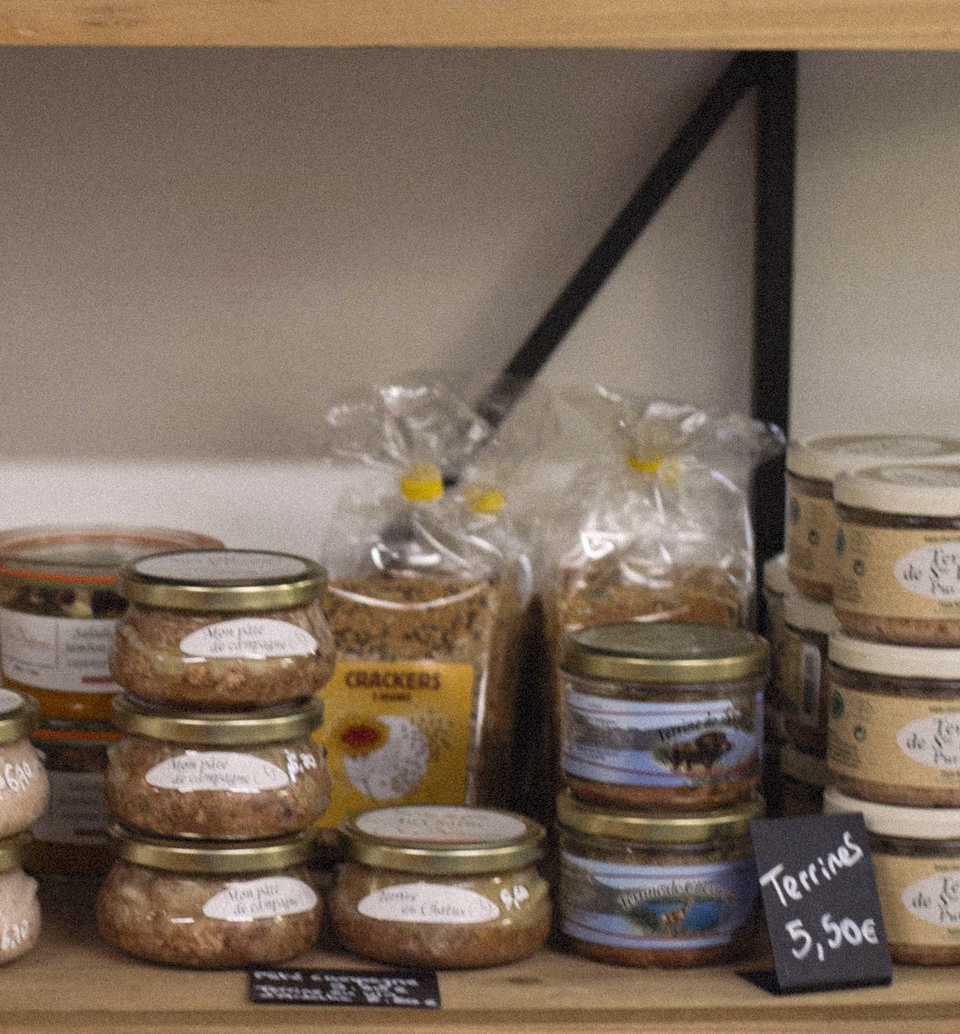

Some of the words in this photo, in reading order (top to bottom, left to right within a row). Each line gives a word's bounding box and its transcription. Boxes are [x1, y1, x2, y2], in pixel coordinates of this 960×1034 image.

[344, 669, 442, 692] CRACKERS
[758, 830, 865, 908] Terrines
[785, 912, 879, 962] 5,50€
